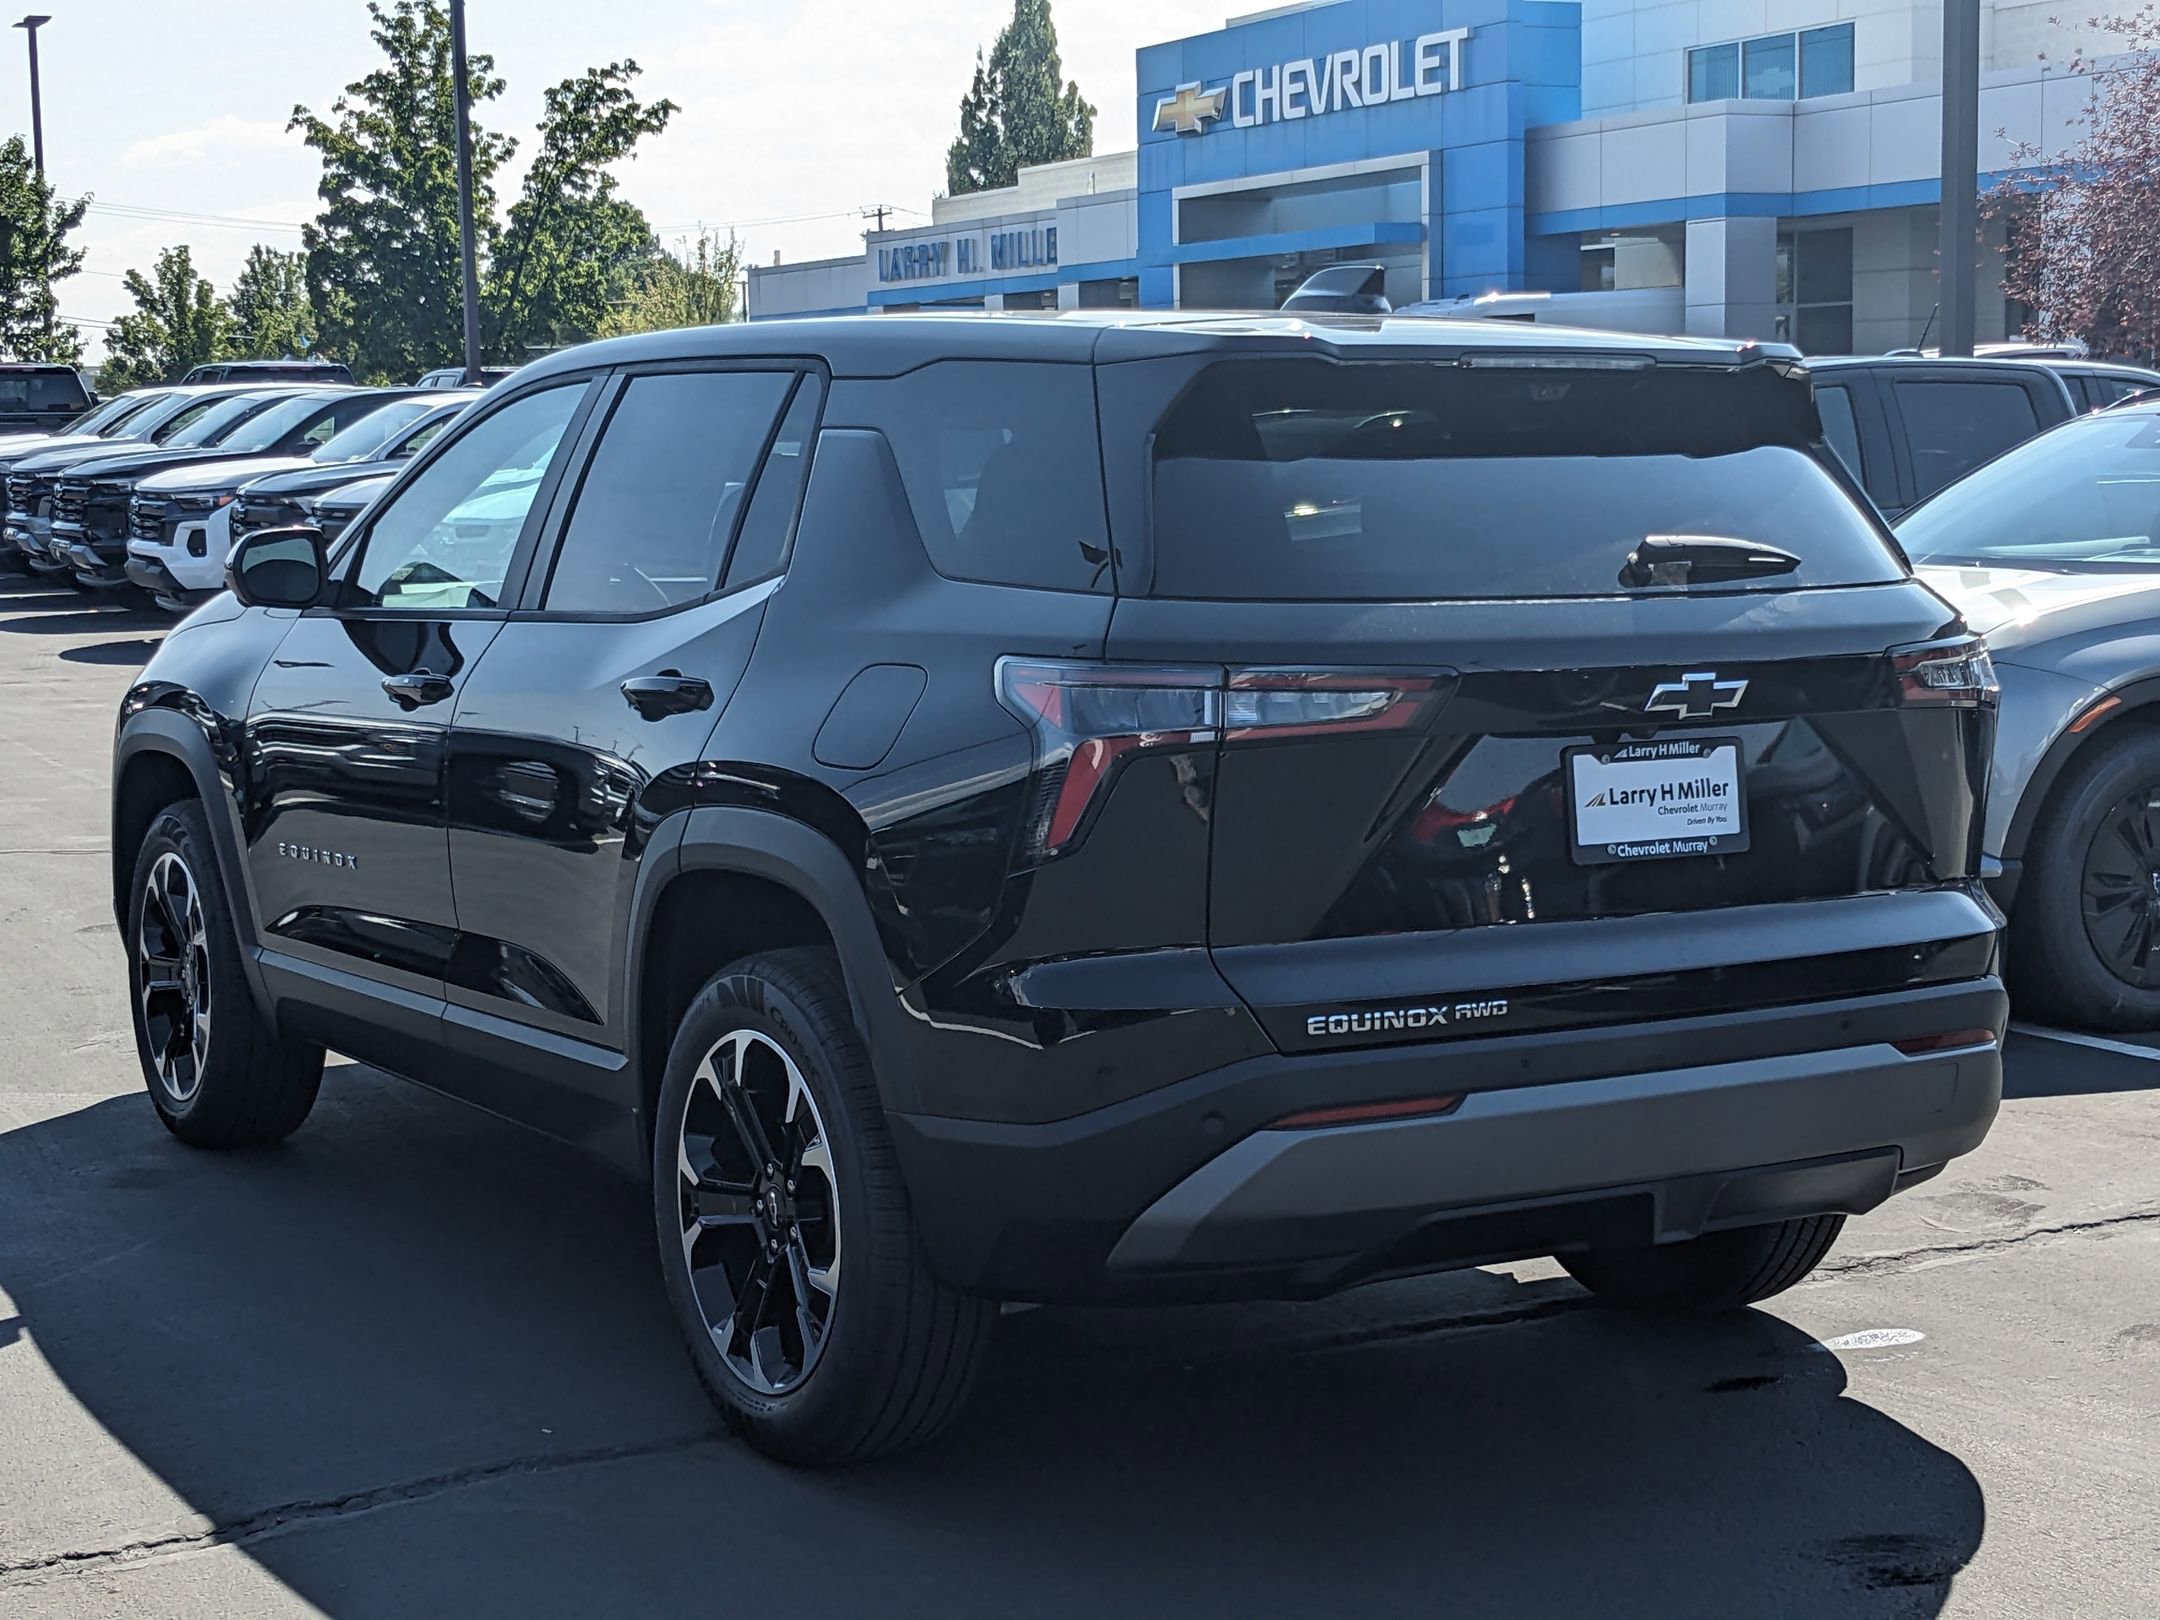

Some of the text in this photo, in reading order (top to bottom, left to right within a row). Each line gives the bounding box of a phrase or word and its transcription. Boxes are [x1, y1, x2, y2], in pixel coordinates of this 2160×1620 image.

[1231, 26, 1469, 129] CHEVROLET
[878, 241, 949, 283] LARRY
[1628, 740, 1701, 760] Larry H Miller
[1608, 777, 1729, 808] Larry H Miller
[1657, 801, 1728, 816] Chevrolet Murray
[278, 842, 358, 870] EQUINOX
[1617, 840, 1709, 858] Chevrolet Murray
[1306, 1000, 1508, 1036] EQUINOX AWD
